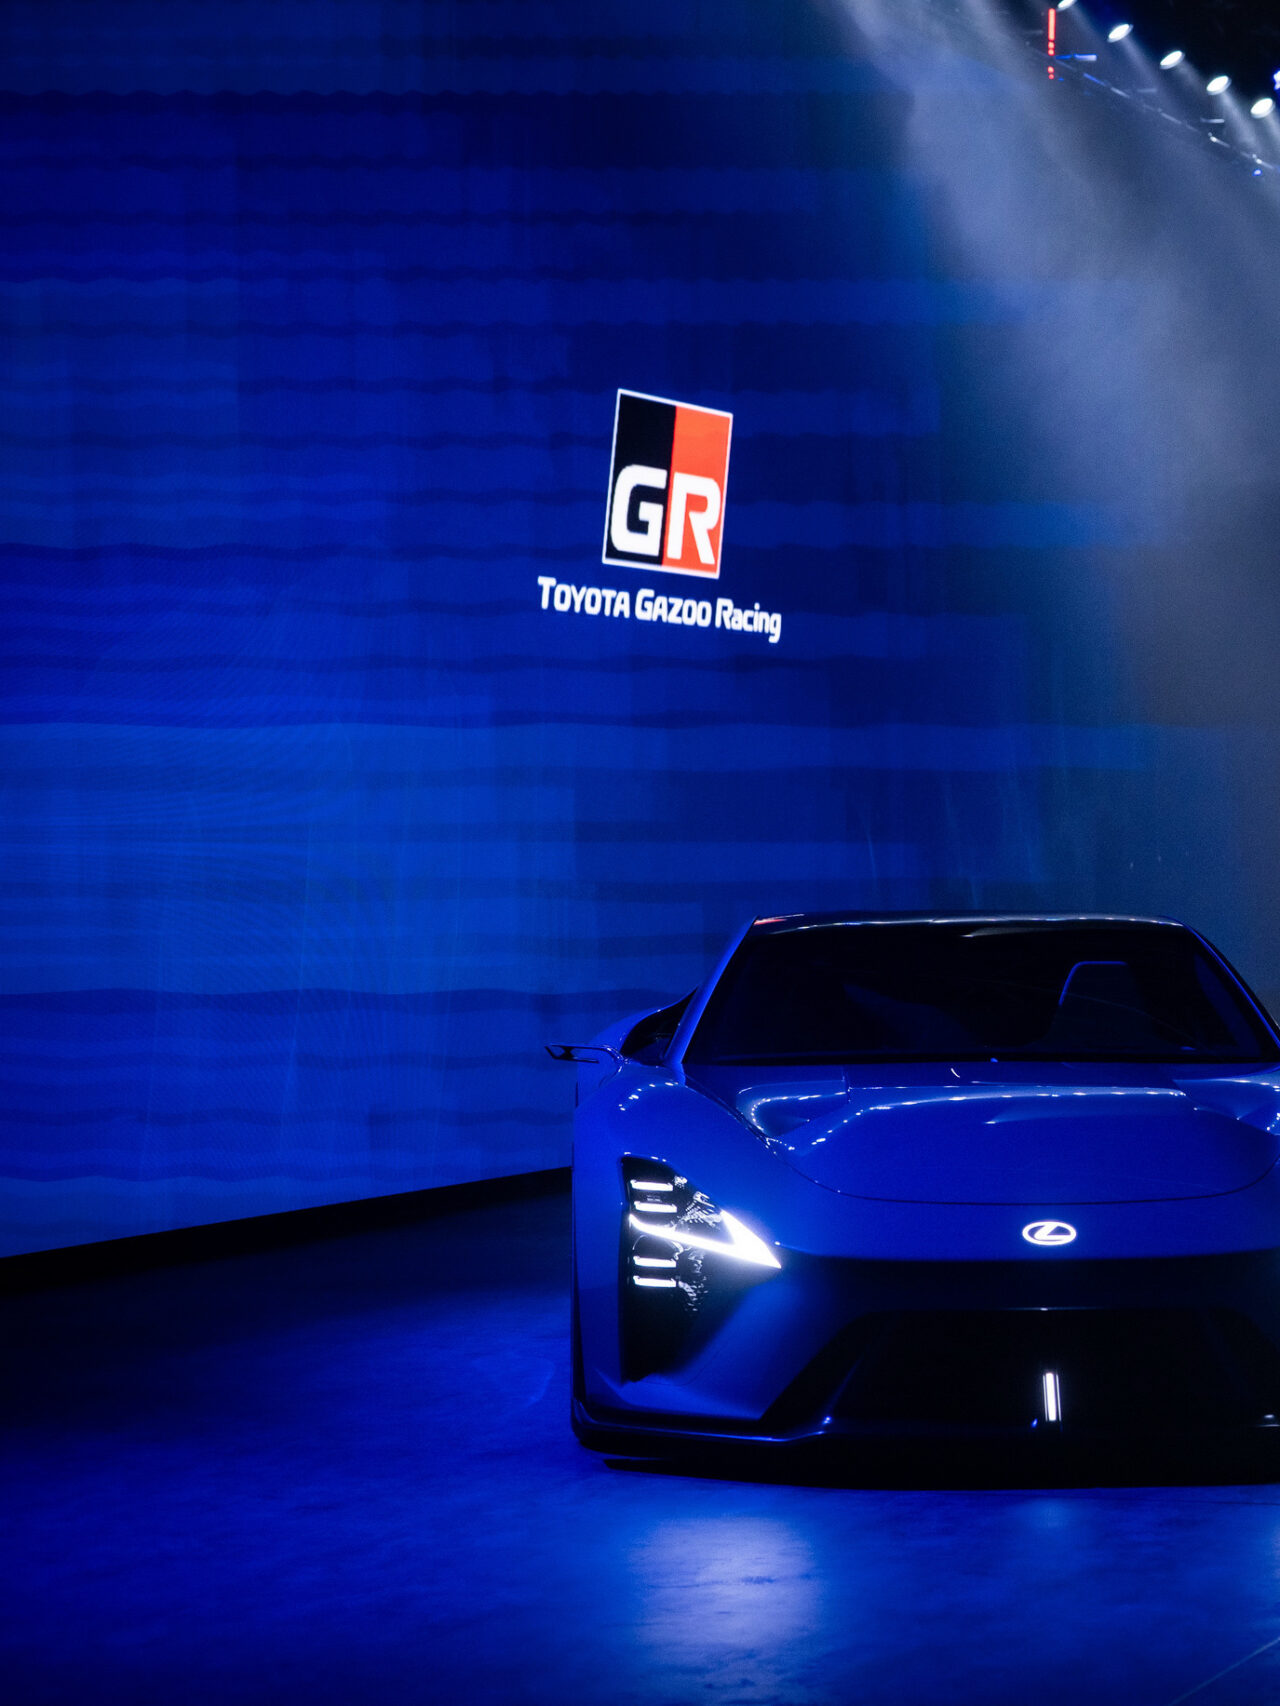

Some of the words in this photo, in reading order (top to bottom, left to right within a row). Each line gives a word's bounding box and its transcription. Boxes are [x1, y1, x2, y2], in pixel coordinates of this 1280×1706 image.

[610, 464, 721, 564] GR
[538, 576, 630, 618] TOYOTA
[635, 589, 712, 627] GAZOO
[715, 598, 782, 643] Racing
